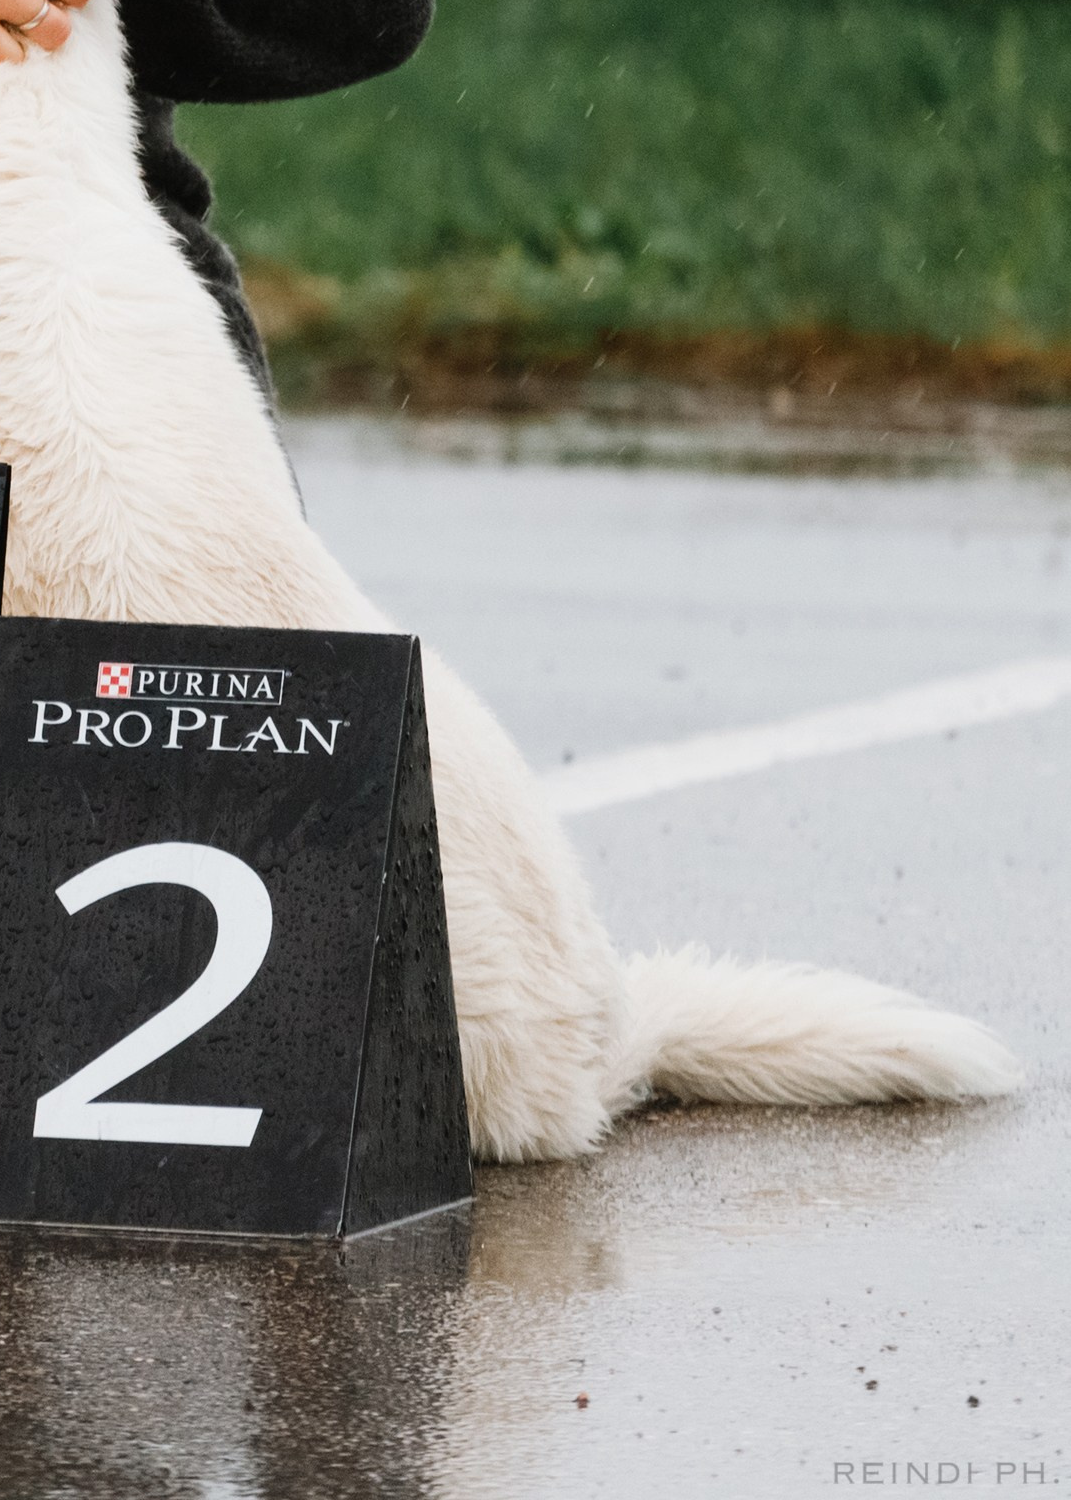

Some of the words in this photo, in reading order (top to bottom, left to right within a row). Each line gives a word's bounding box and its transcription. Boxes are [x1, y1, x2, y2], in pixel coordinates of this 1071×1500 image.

[136, 670, 275, 699] PURINA
[28, 700, 153, 748] PRO
[162, 706, 343, 756] PLAN
[33, 841, 273, 1147] 2
